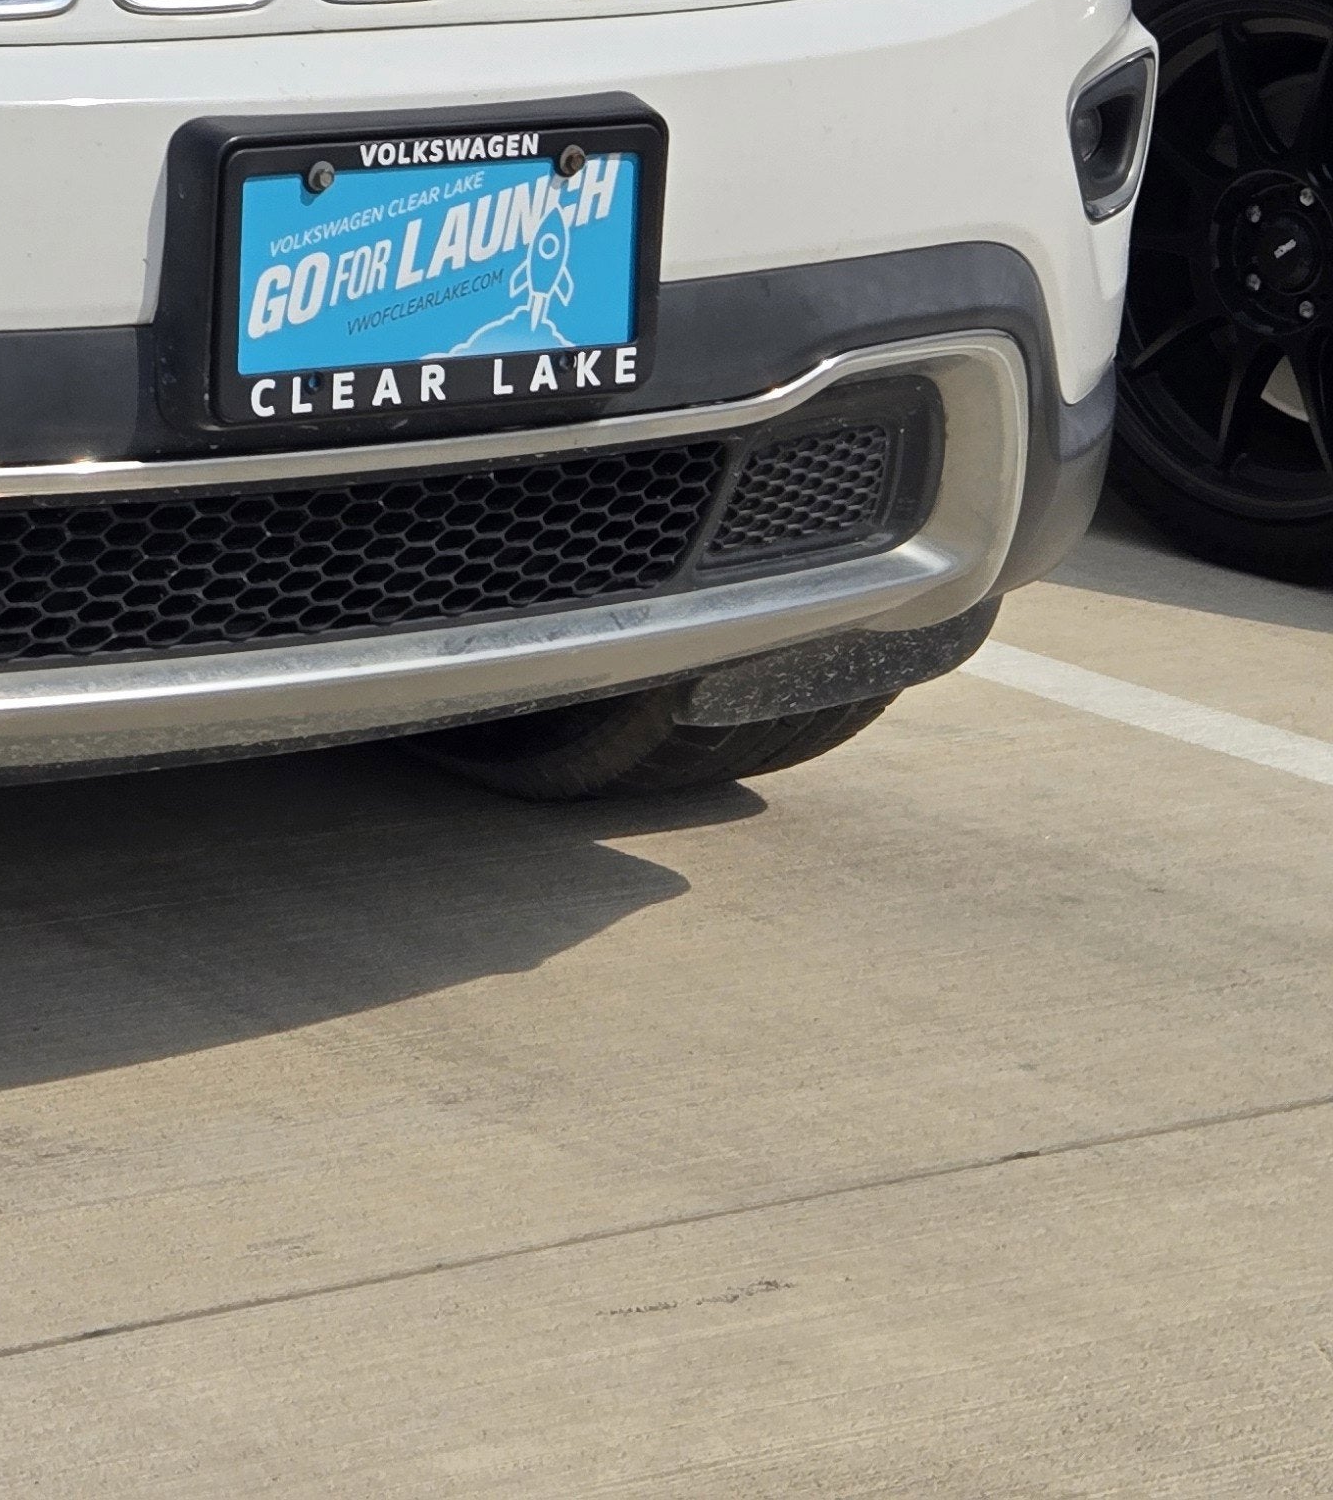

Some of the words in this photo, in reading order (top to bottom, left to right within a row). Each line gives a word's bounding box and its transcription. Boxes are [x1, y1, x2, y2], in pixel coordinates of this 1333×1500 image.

[359, 133, 539, 167] VOLKSWAGEN
[269, 205, 384, 257] VOLKSWAGEN
[387, 185, 440, 220] CLEAR
[443, 171, 486, 201] LAKE
[247, 251, 331, 339] GO
[329, 239, 393, 306] FOR
[346, 268, 505, 336] VWOFCLEARLAKE.COM
[250, 364, 447, 418] CLEAR
[493, 346, 638, 396] LAKE
